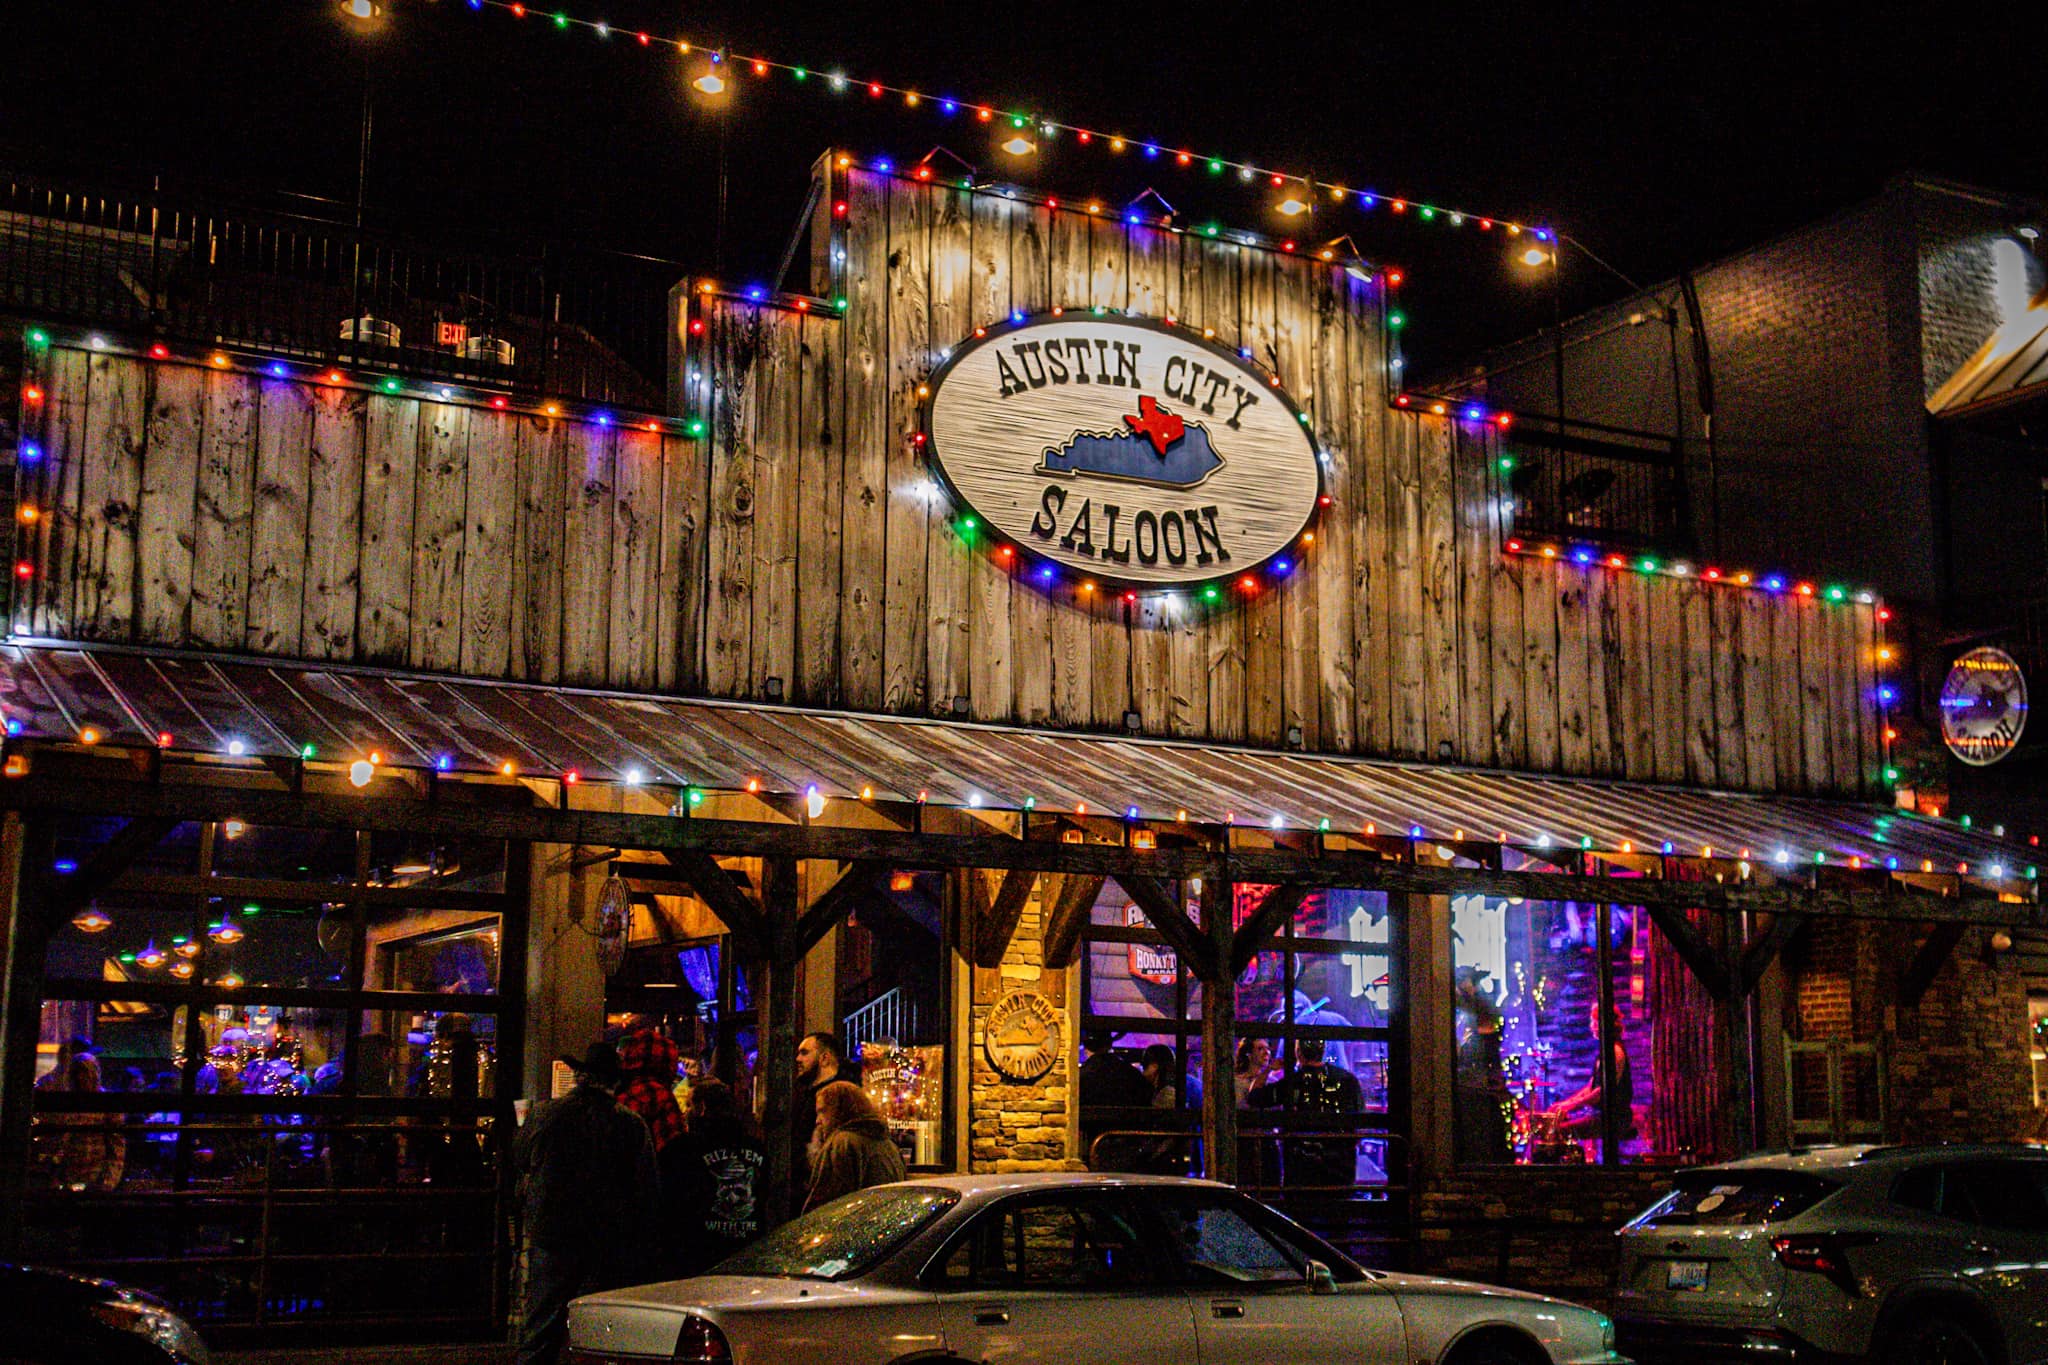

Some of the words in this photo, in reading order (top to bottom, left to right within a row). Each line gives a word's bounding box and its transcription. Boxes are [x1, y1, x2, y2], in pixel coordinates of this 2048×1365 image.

[441, 323, 465, 343] EXIT
[996, 338, 1142, 398] AUSTIN
[1164, 355, 1259, 431] CITY
[1030, 484, 1232, 566] SALOON
[868, 1068, 896, 1082] AUSTIN
